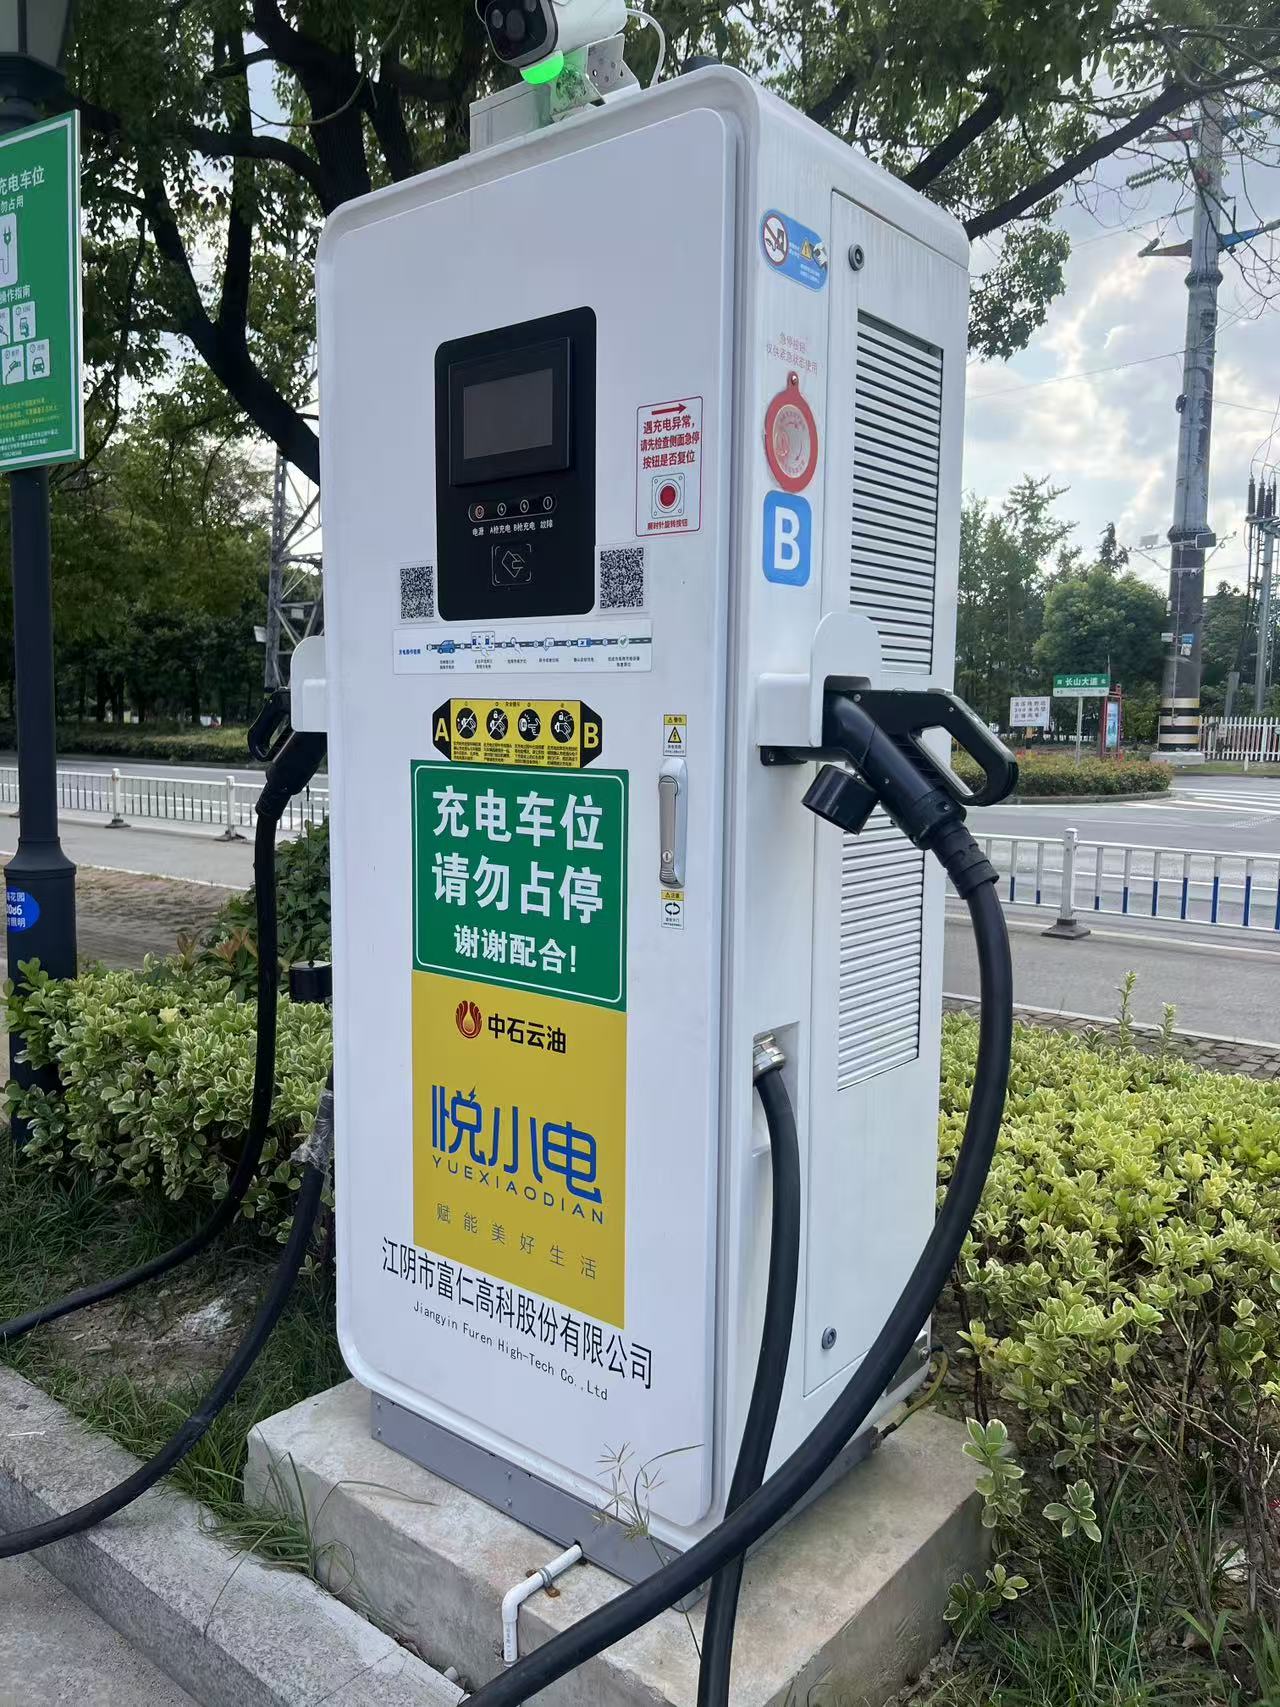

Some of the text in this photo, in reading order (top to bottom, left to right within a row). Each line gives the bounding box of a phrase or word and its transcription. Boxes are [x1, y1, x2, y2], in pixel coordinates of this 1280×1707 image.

[0, 165, 45, 196] 充电车位
[640, 431, 700, 452] 请先检查侧面急停
[643, 415, 695, 435] 遇充电异常，
[642, 450, 696, 469] 按钮是否复位
[490, 524, 512, 534] A枪充电
[513, 521, 536, 532] B枪充电
[540, 519, 553, 529] 故障
[774, 505, 800, 571] B
[1065, 677, 1099, 686] 长山大道
[434, 718, 450, 742] A
[583, 722, 599, 749] B
[432, 785, 604, 851] 充电车位
[432, 852, 603, 924] 请勿占停
[454, 924, 577, 974] 谢谢配合！
[488, 1013, 567, 1054] 中石云油
[431, 1084, 603, 1204] 悦小电
[432, 1155, 603, 1225] YUEXIAODIAN
[437, 1203, 596, 1280] 赋能美好生活
[381, 1236, 652, 1390] 江阴市富仁高科股份有限公司
[413, 1301, 458, 1331] Jiangyin
[463, 1322, 493, 1347] Furen
[498, 1338, 555, 1376] High-Tech
